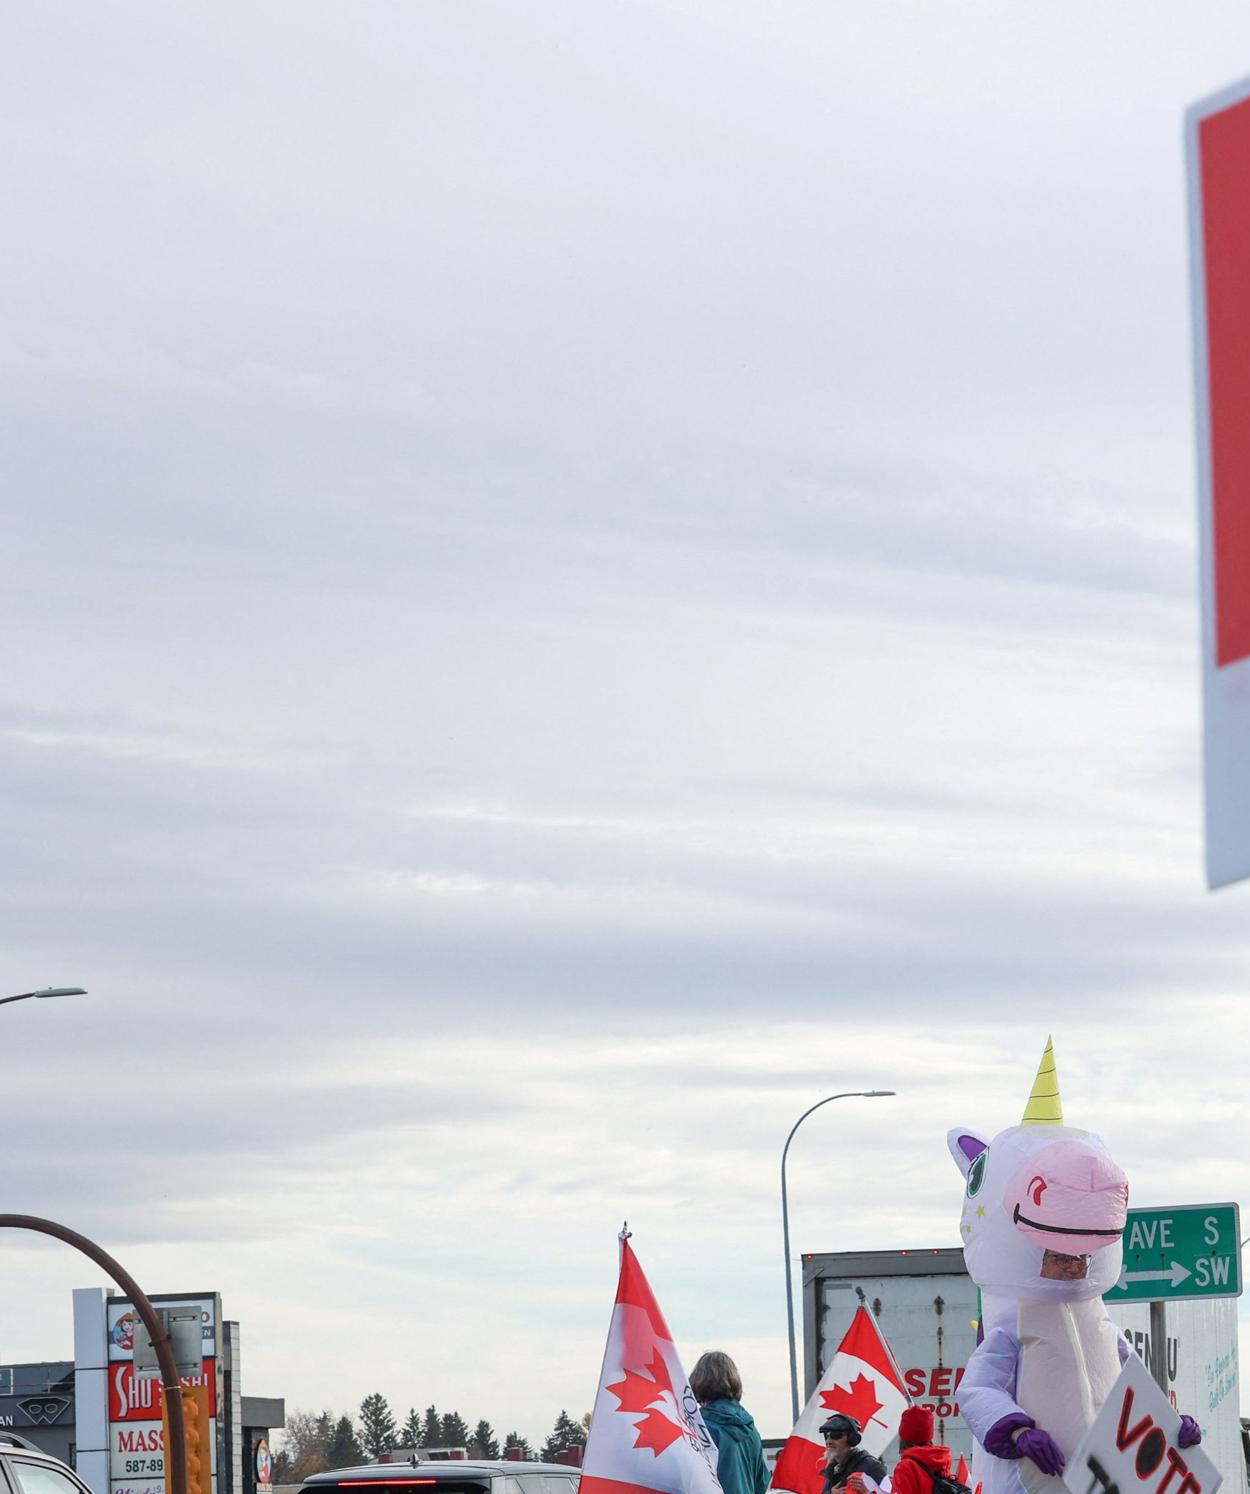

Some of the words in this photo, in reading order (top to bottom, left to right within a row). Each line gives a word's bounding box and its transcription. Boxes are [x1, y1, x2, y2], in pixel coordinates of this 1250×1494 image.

[1128, 1218, 1175, 1250] AVE
[1203, 1216, 1219, 1245] S
[1194, 1256, 1230, 1287] SW
[115, 1366, 151, 1417] SHU
